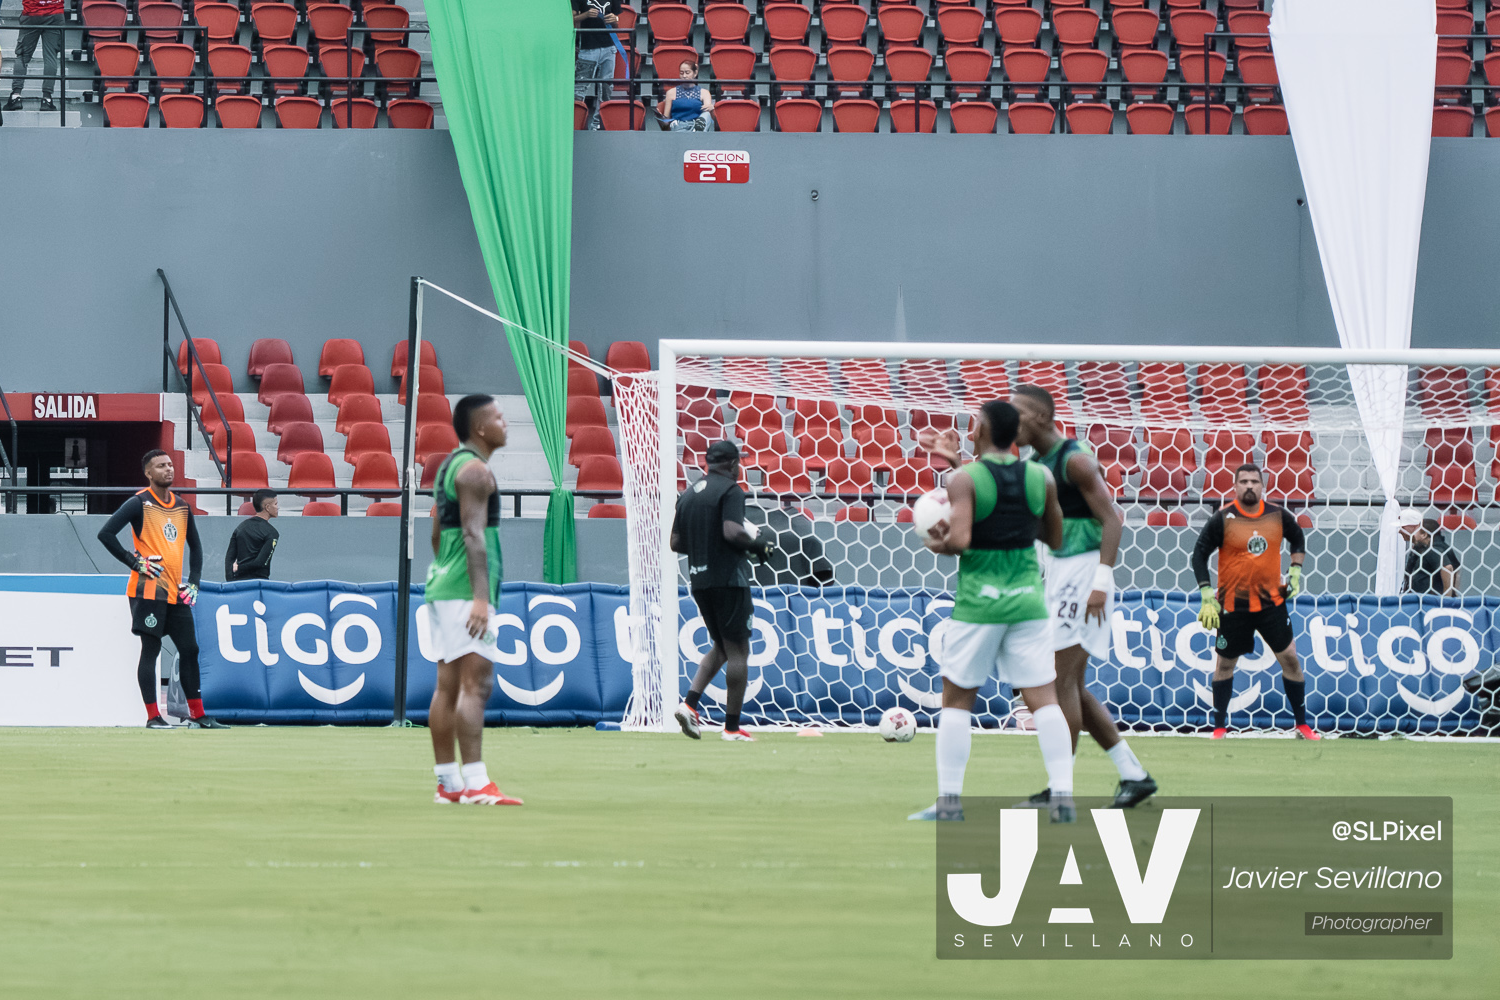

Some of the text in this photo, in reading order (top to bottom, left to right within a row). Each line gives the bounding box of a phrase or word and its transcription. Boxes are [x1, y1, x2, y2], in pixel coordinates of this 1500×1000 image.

[689, 152, 745, 162] SECCION
[699, 164, 731, 181] 27
[34, 394, 97, 419] SALIDA
[1057, 600, 1078, 619] 29
[215, 594, 382, 666] tigo
